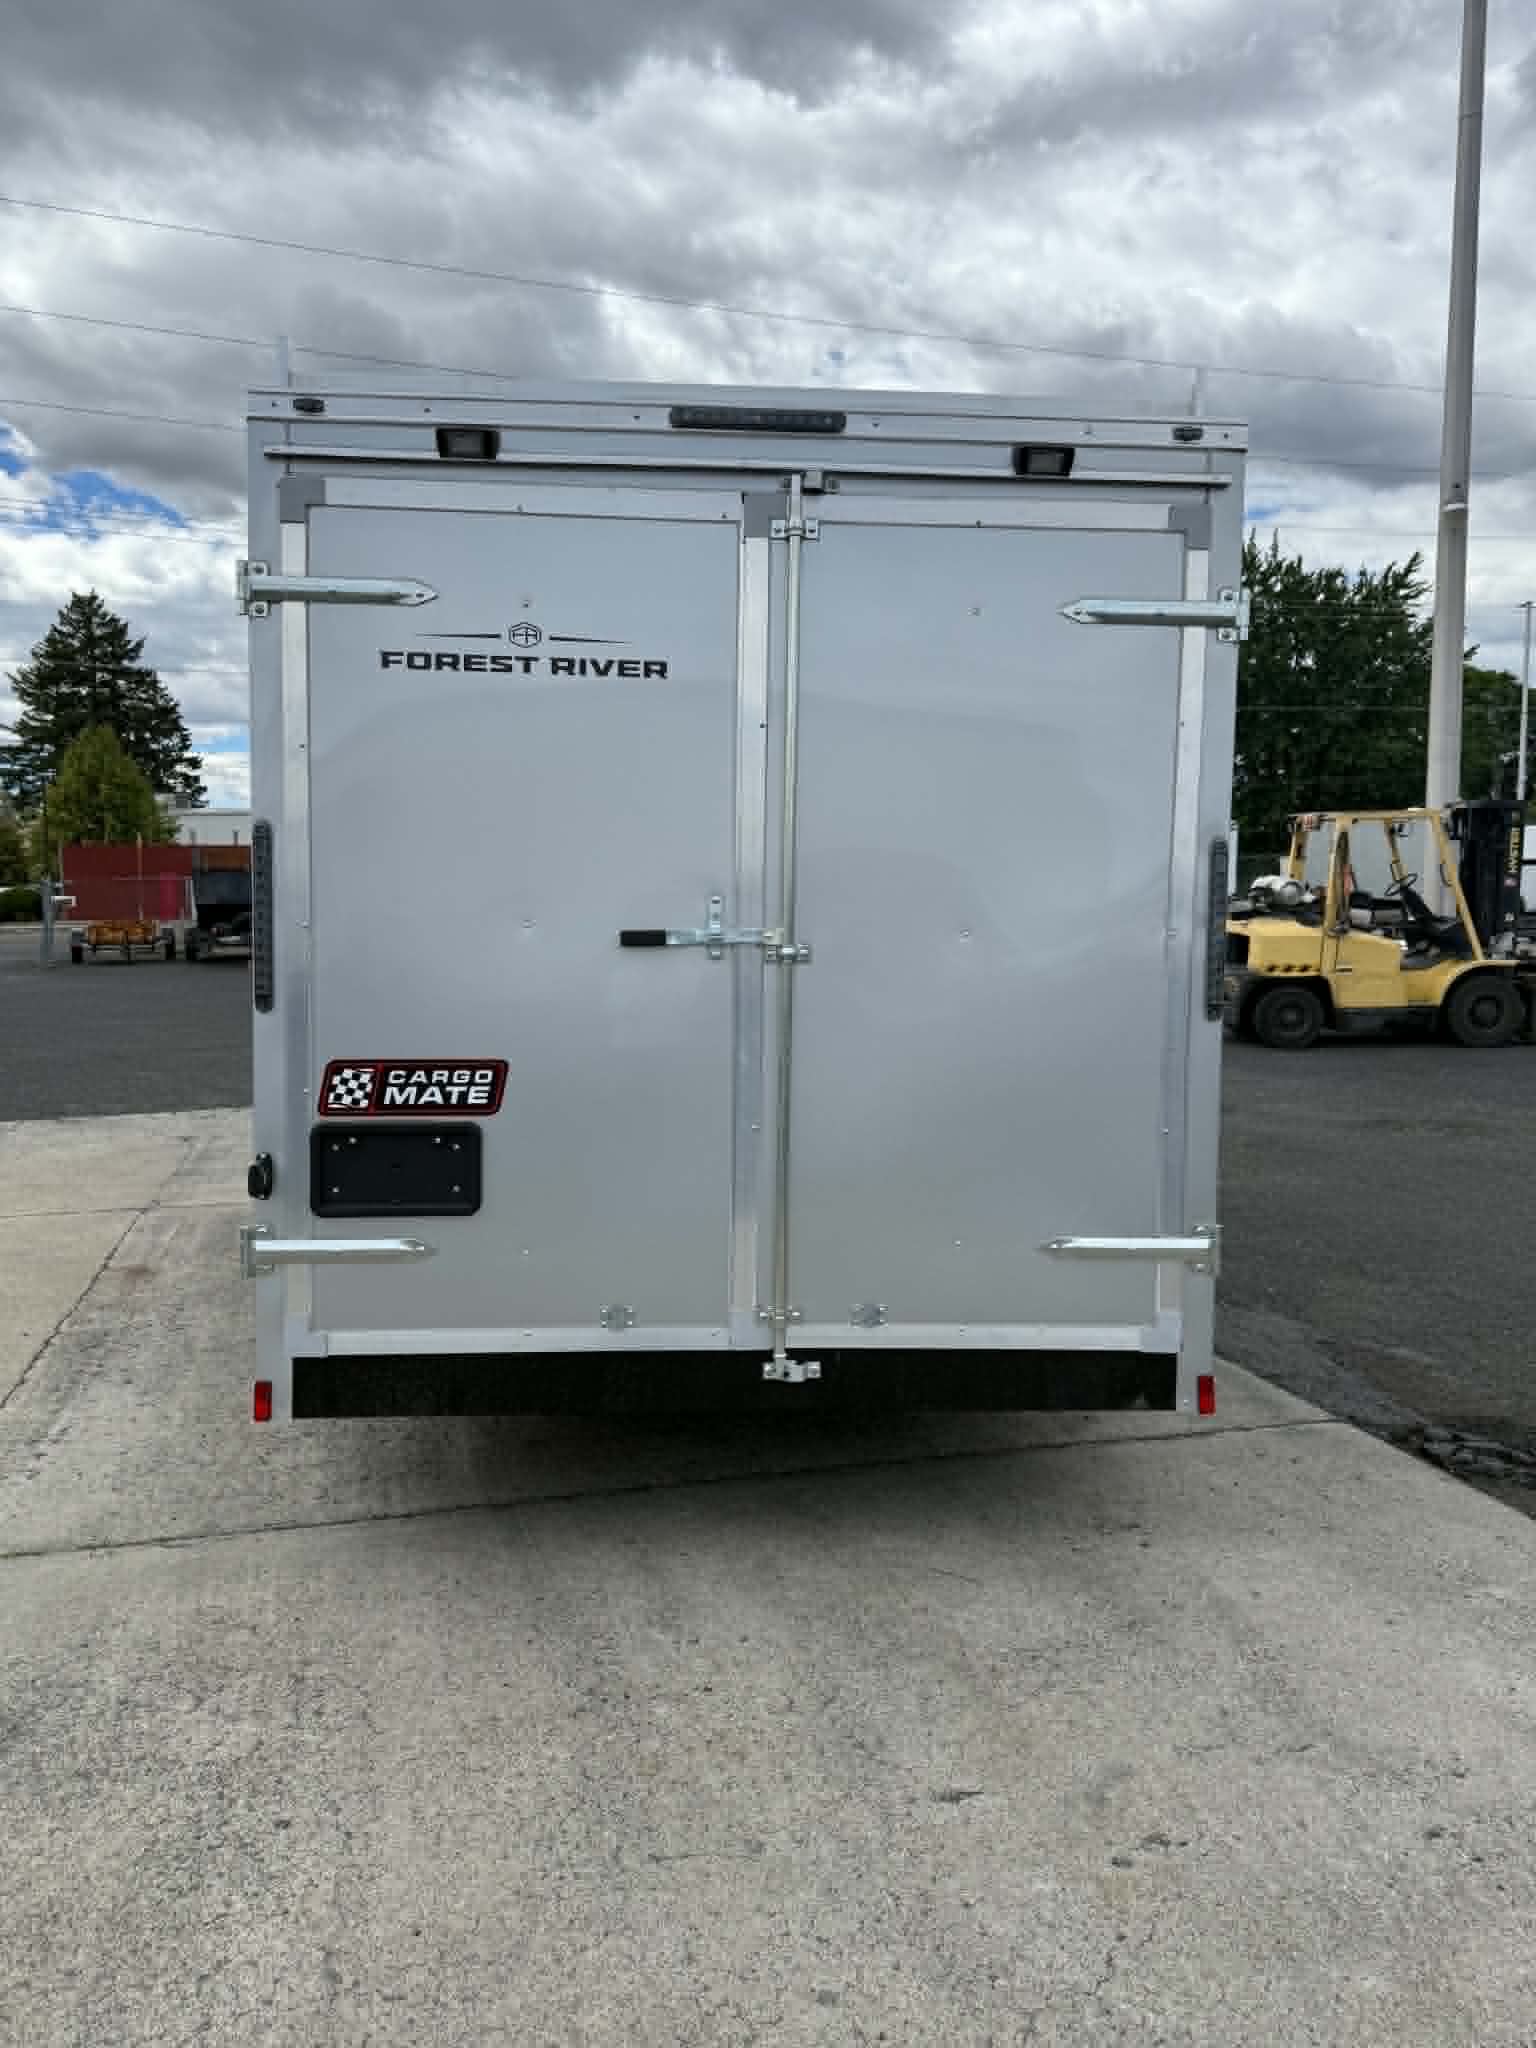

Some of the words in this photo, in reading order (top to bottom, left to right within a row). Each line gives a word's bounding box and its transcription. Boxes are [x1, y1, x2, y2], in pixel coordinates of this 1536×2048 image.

[380, 651, 539, 674] FOREST
[550, 657, 669, 679] RIVER
[388, 1070, 493, 1084] CARGO
[383, 1086, 491, 1104] MATE
